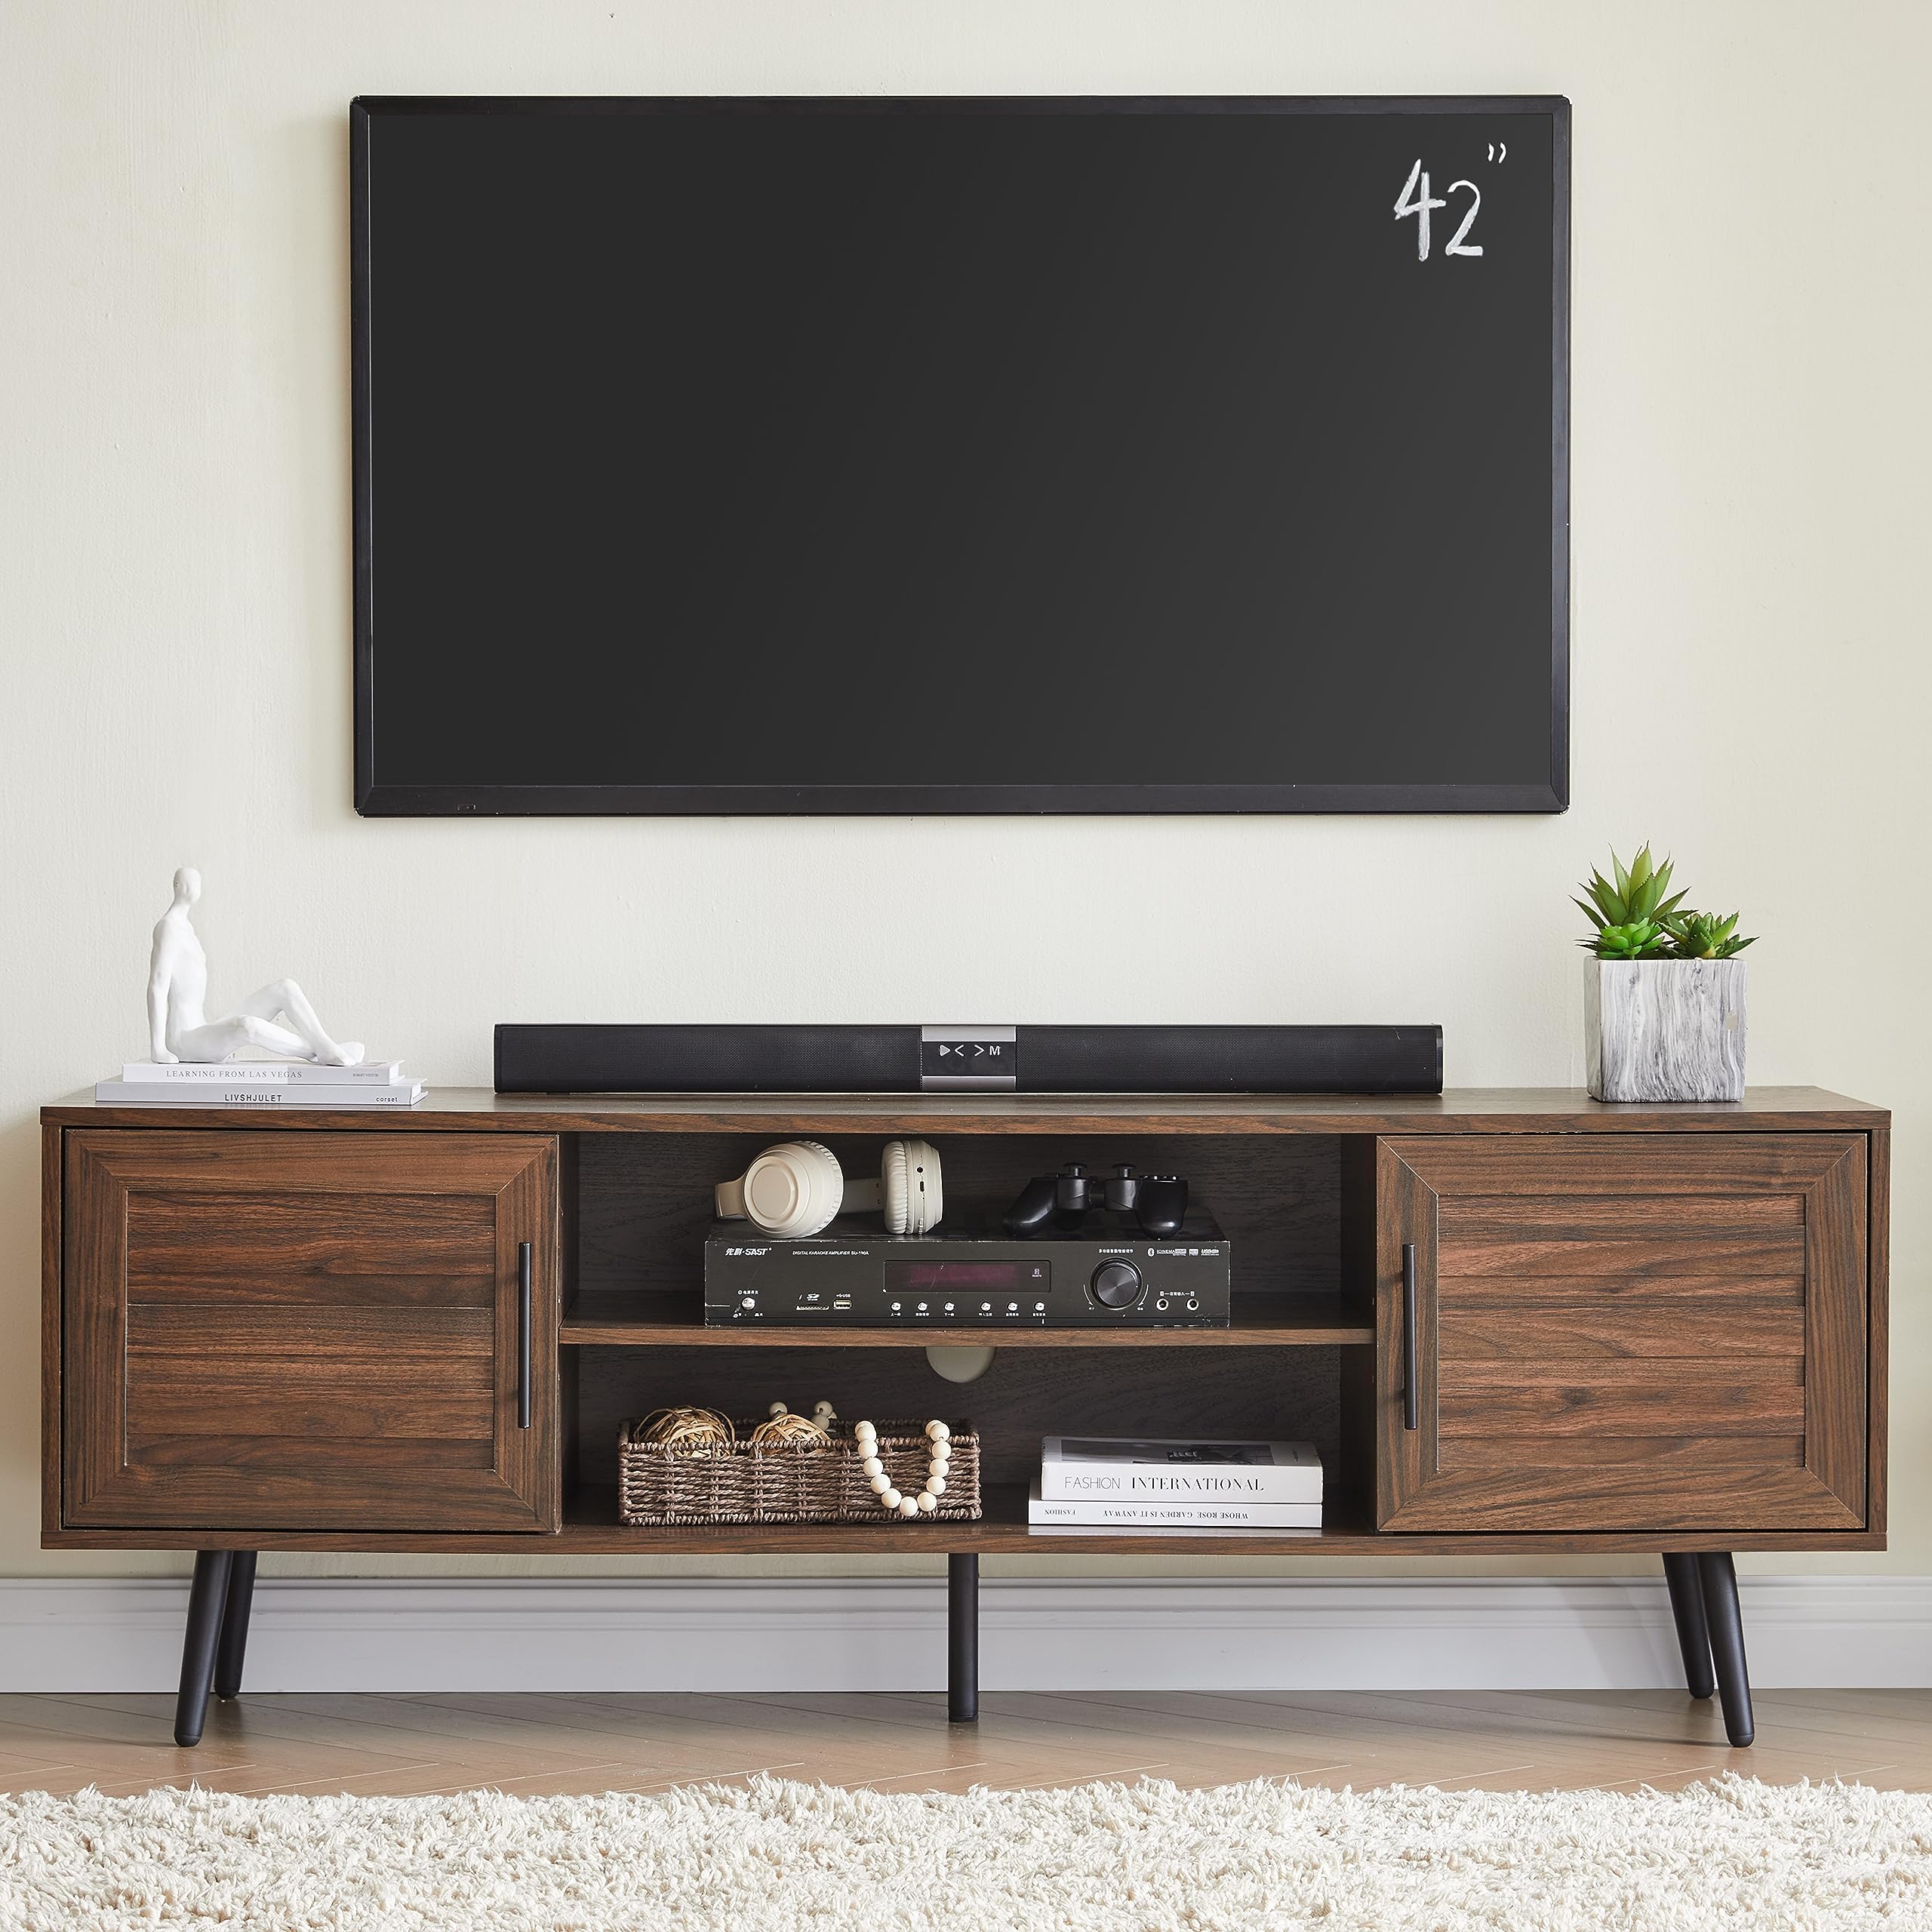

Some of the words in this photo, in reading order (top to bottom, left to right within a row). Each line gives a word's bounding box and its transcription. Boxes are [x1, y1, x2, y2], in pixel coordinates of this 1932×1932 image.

[166, 1069, 217, 1078] LEARNING
[219, 1069, 246, 1078] FROM
[248, 1069, 267, 1078] LAS
[270, 1069, 303, 1079] VEGAS
[224, 1093, 283, 1103] LIVSHJULET
[1065, 1476, 1121, 1490] FASHION
[1131, 1477, 1264, 1491] INTERNATIONAL
